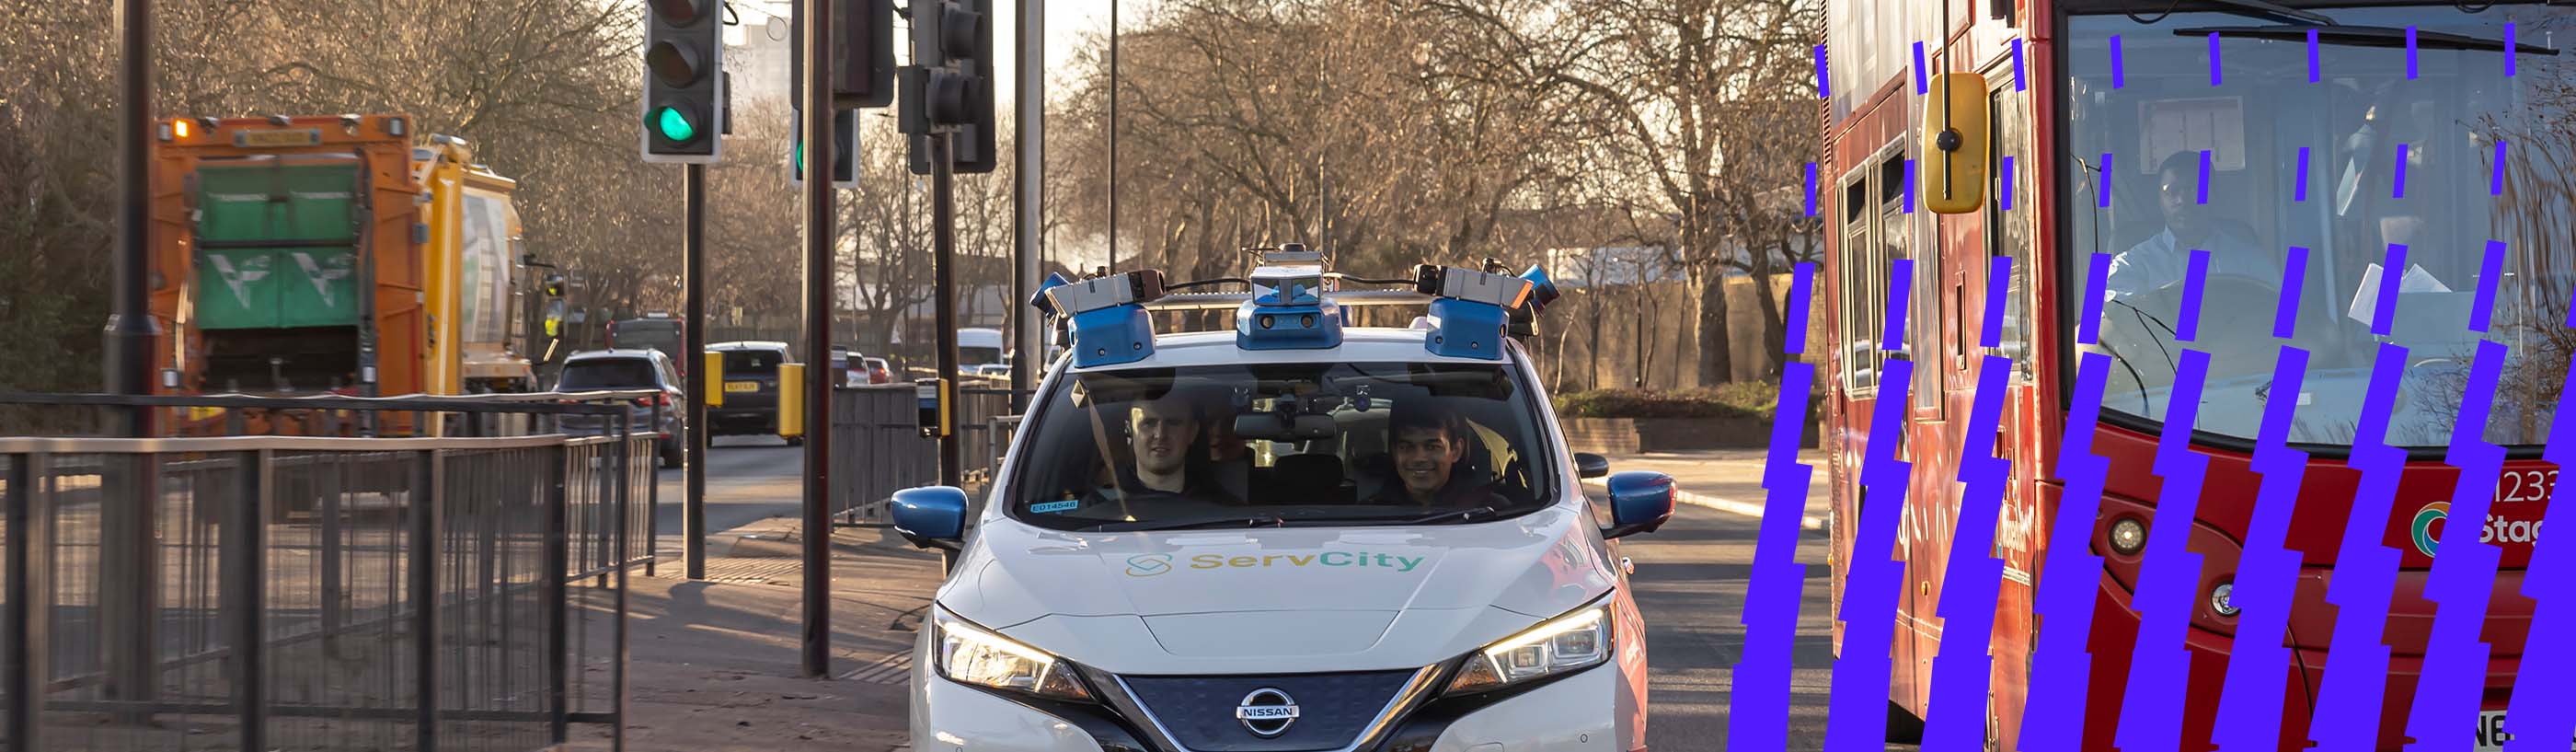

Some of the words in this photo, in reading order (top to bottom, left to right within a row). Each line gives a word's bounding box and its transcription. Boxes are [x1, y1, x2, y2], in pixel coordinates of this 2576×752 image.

[2495, 470, 2559, 502] 123
[1190, 552, 1424, 573] ServCity
[1243, 708, 1293, 717] NISSAN
